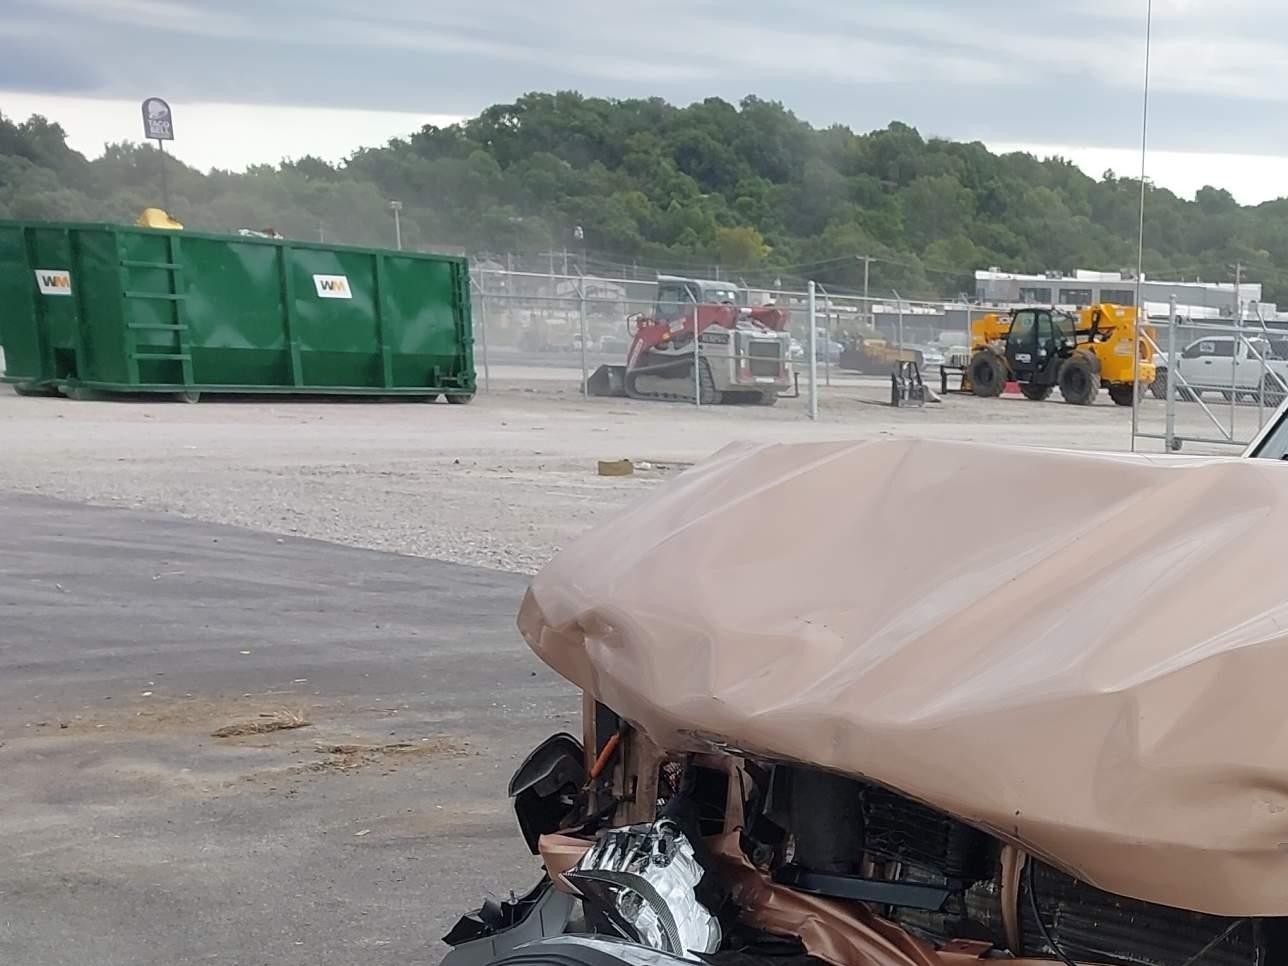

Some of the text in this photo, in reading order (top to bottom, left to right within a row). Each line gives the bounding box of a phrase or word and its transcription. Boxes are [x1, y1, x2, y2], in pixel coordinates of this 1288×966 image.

[147, 119, 170, 128] TACO
[42, 275, 70, 288] WM
[320, 279, 346, 291] WM
